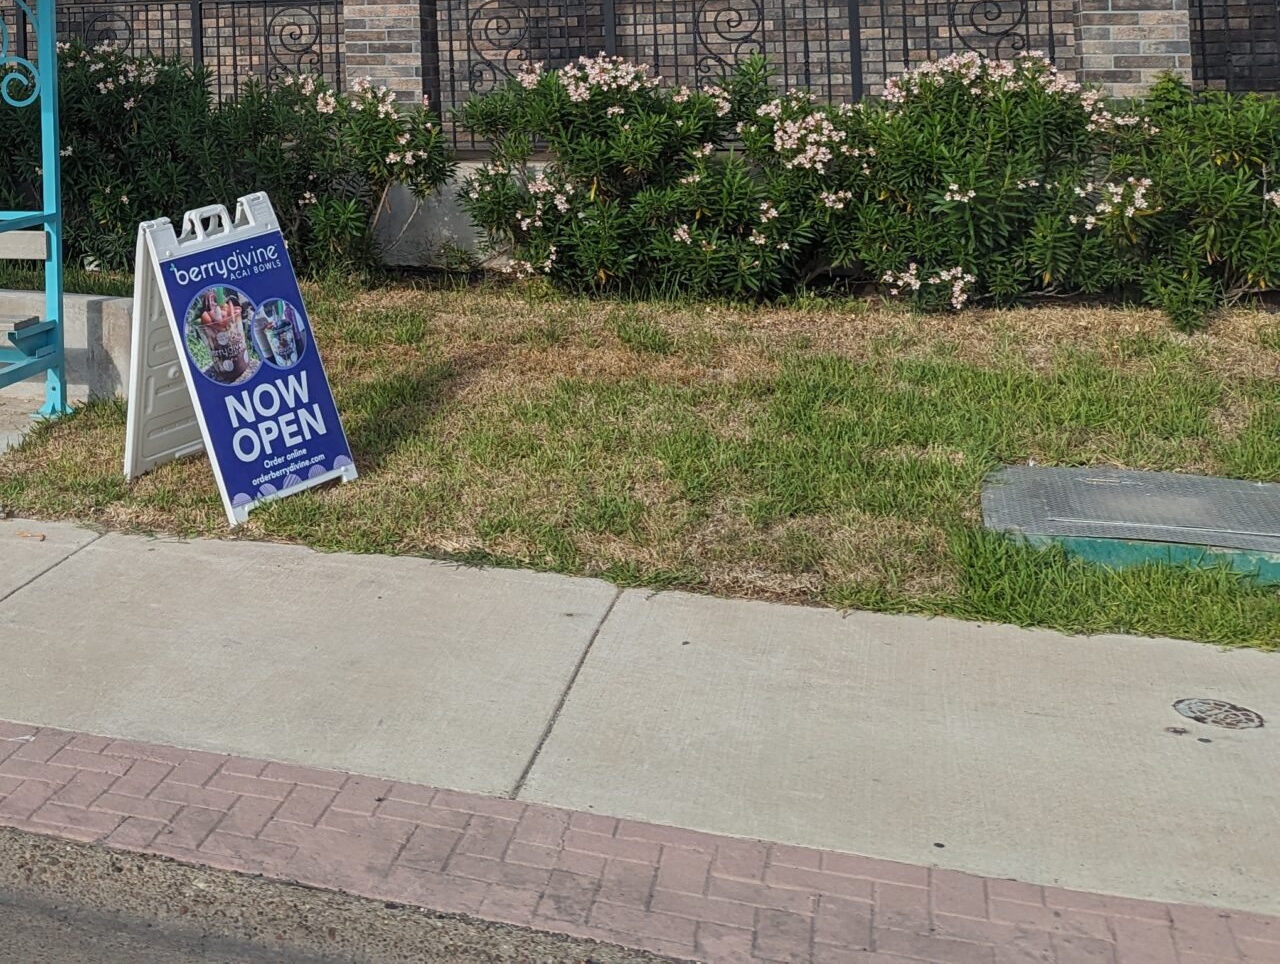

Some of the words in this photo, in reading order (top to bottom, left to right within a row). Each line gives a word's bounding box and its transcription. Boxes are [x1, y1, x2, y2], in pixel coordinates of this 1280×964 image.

[173, 244, 278, 285] berrydivine
[230, 269, 251, 281] ACAI
[253, 259, 282, 274] BOWLS
[224, 370, 310, 428] NOW
[232, 403, 327, 463] OPEN
[251, 453, 325, 486] orderberrydivine.com
[263, 455, 285, 469] Order
[286, 448, 307, 461] online
